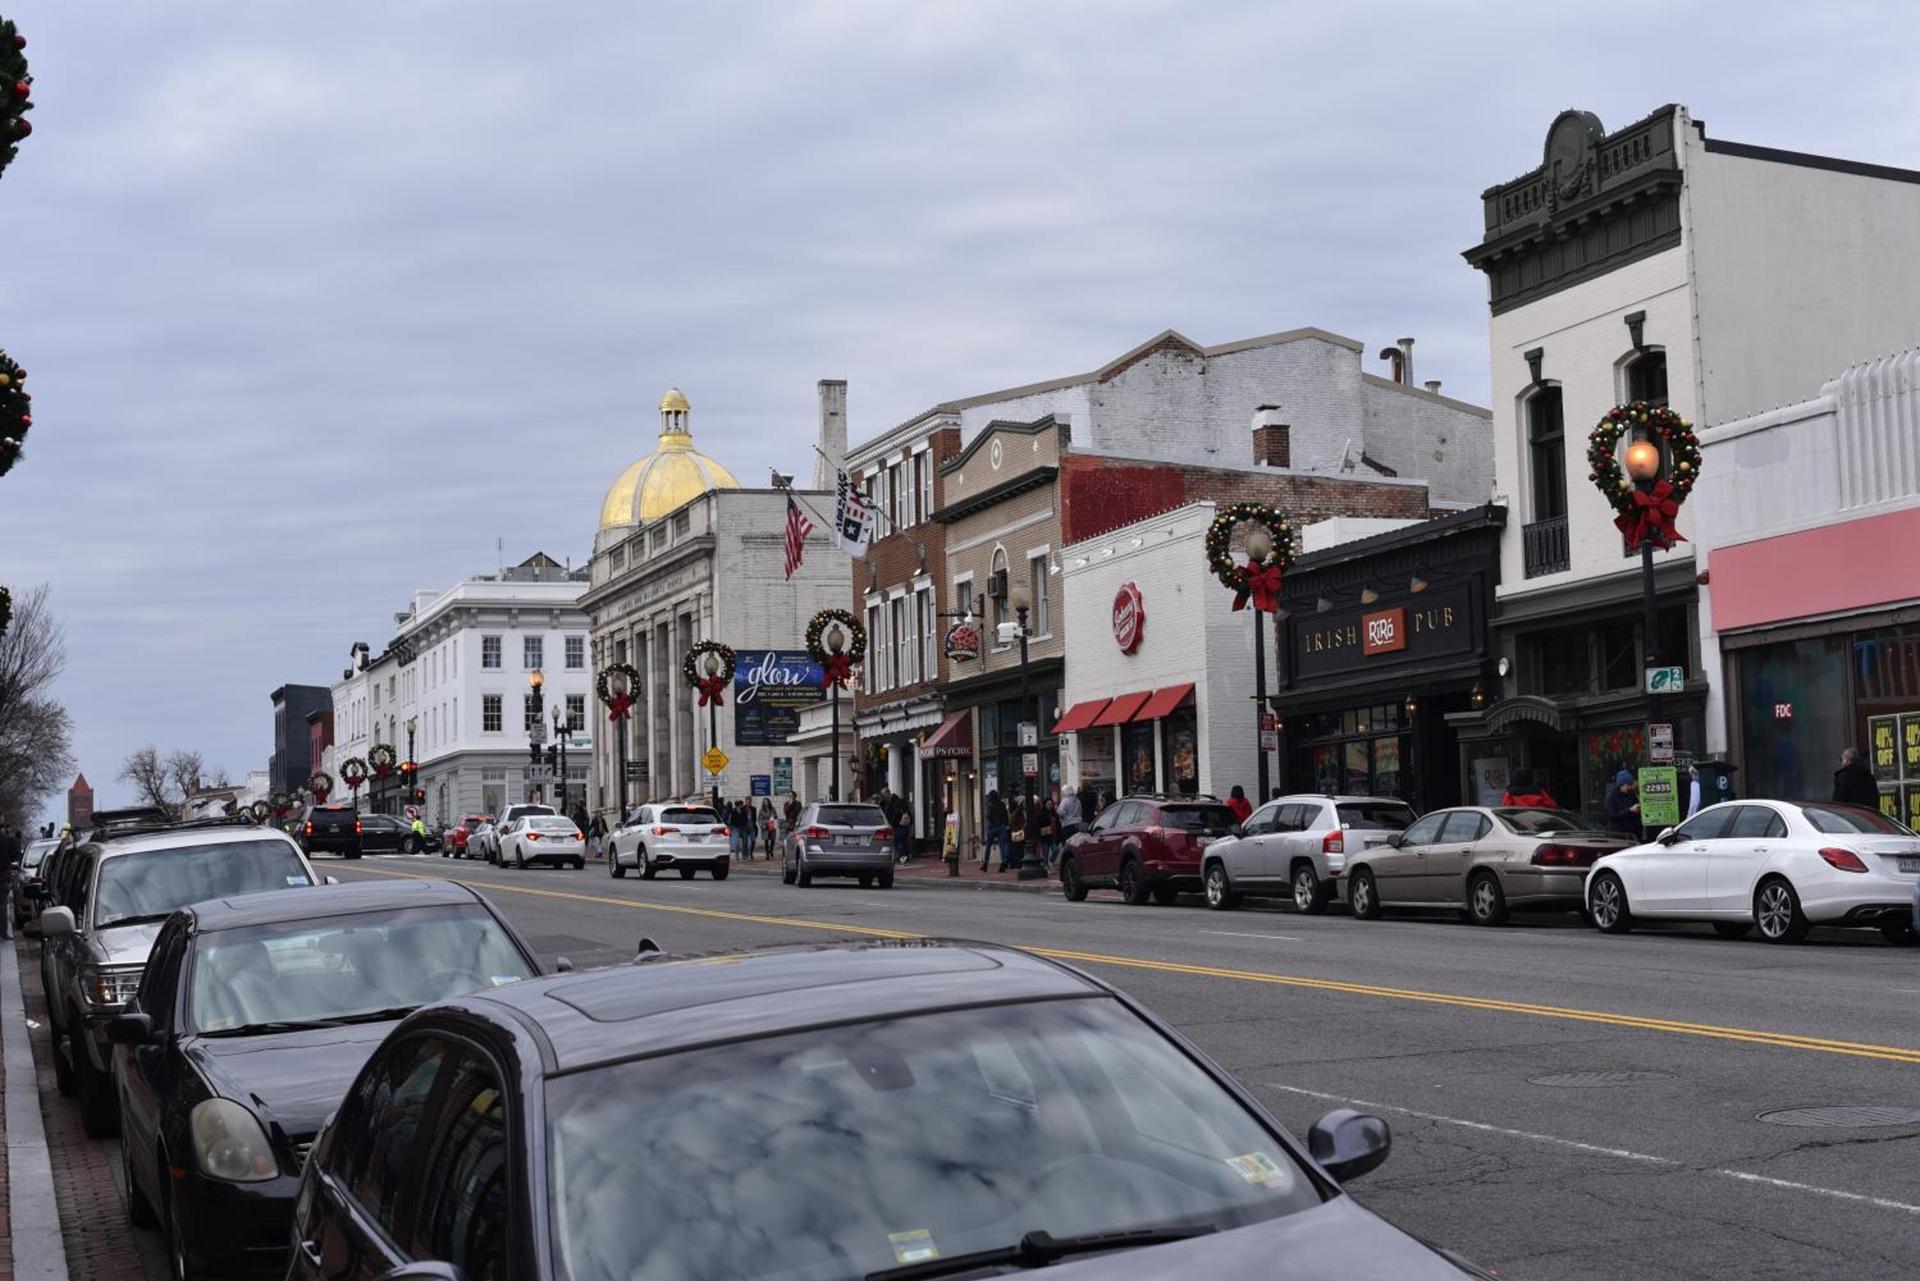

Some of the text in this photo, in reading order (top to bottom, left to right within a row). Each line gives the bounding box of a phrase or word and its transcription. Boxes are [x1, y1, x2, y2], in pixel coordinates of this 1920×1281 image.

[1306, 626, 1356, 652] IRISH
[1415, 607, 1453, 632] PUB
[736, 652, 809, 704] glow
[936, 746, 973, 755] PSYCHIC
[1877, 749, 1893, 765] OFF
[1907, 746, 1920, 763] OF
